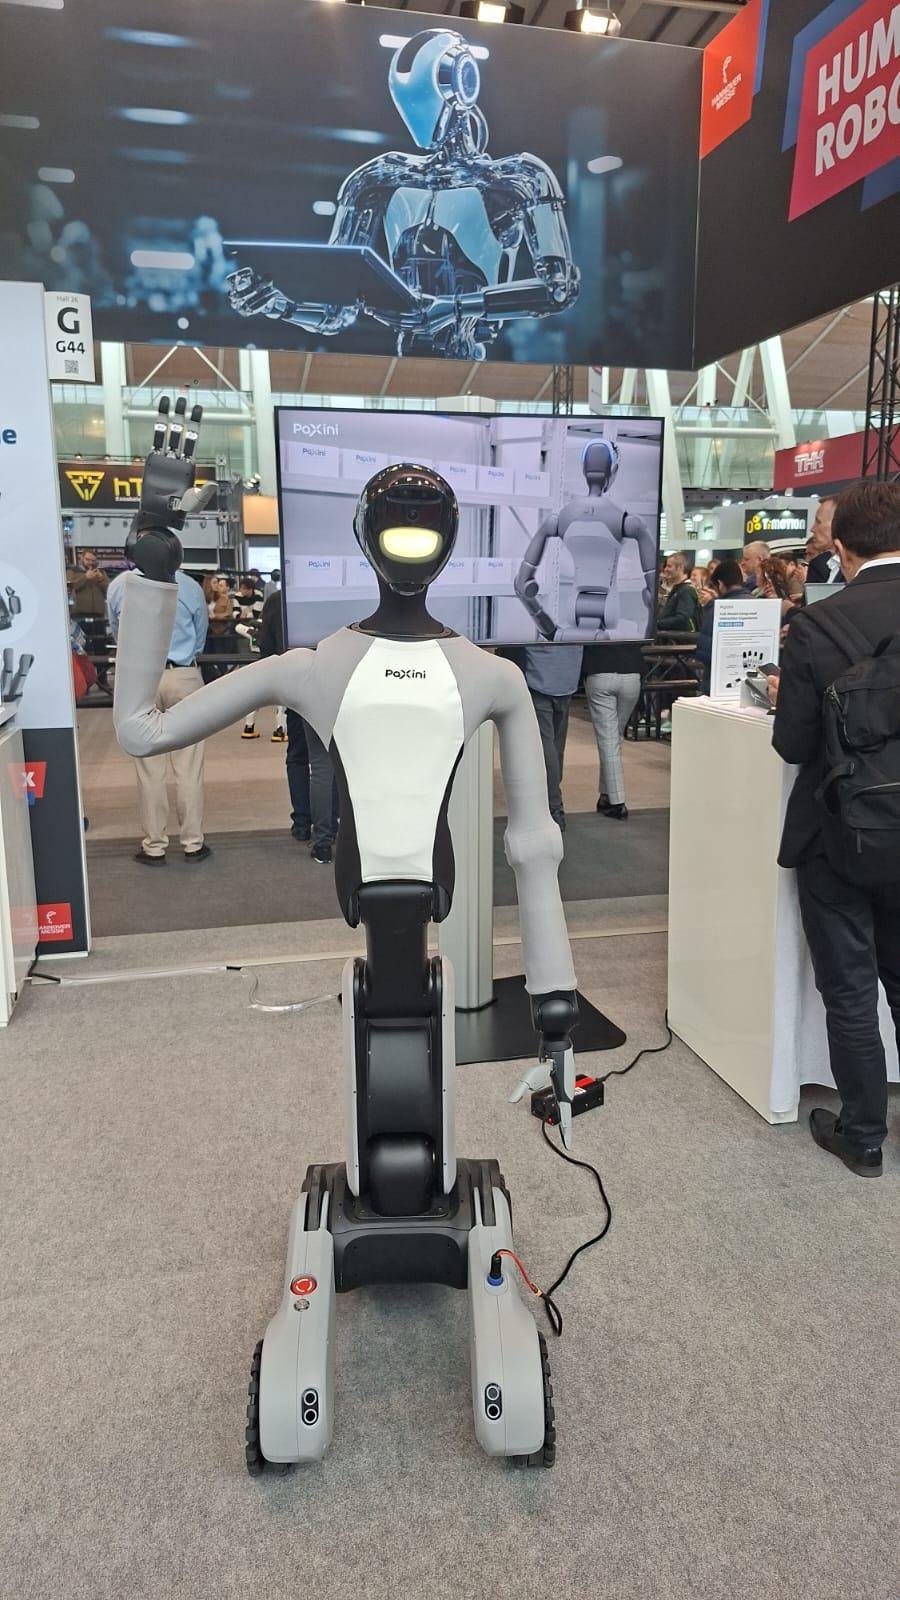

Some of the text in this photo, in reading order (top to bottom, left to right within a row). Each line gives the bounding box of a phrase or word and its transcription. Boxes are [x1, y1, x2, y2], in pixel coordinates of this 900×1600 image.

[57, 307, 80, 334] G
[56, 340, 85, 354] G44
[794, 450, 824, 473] THK
